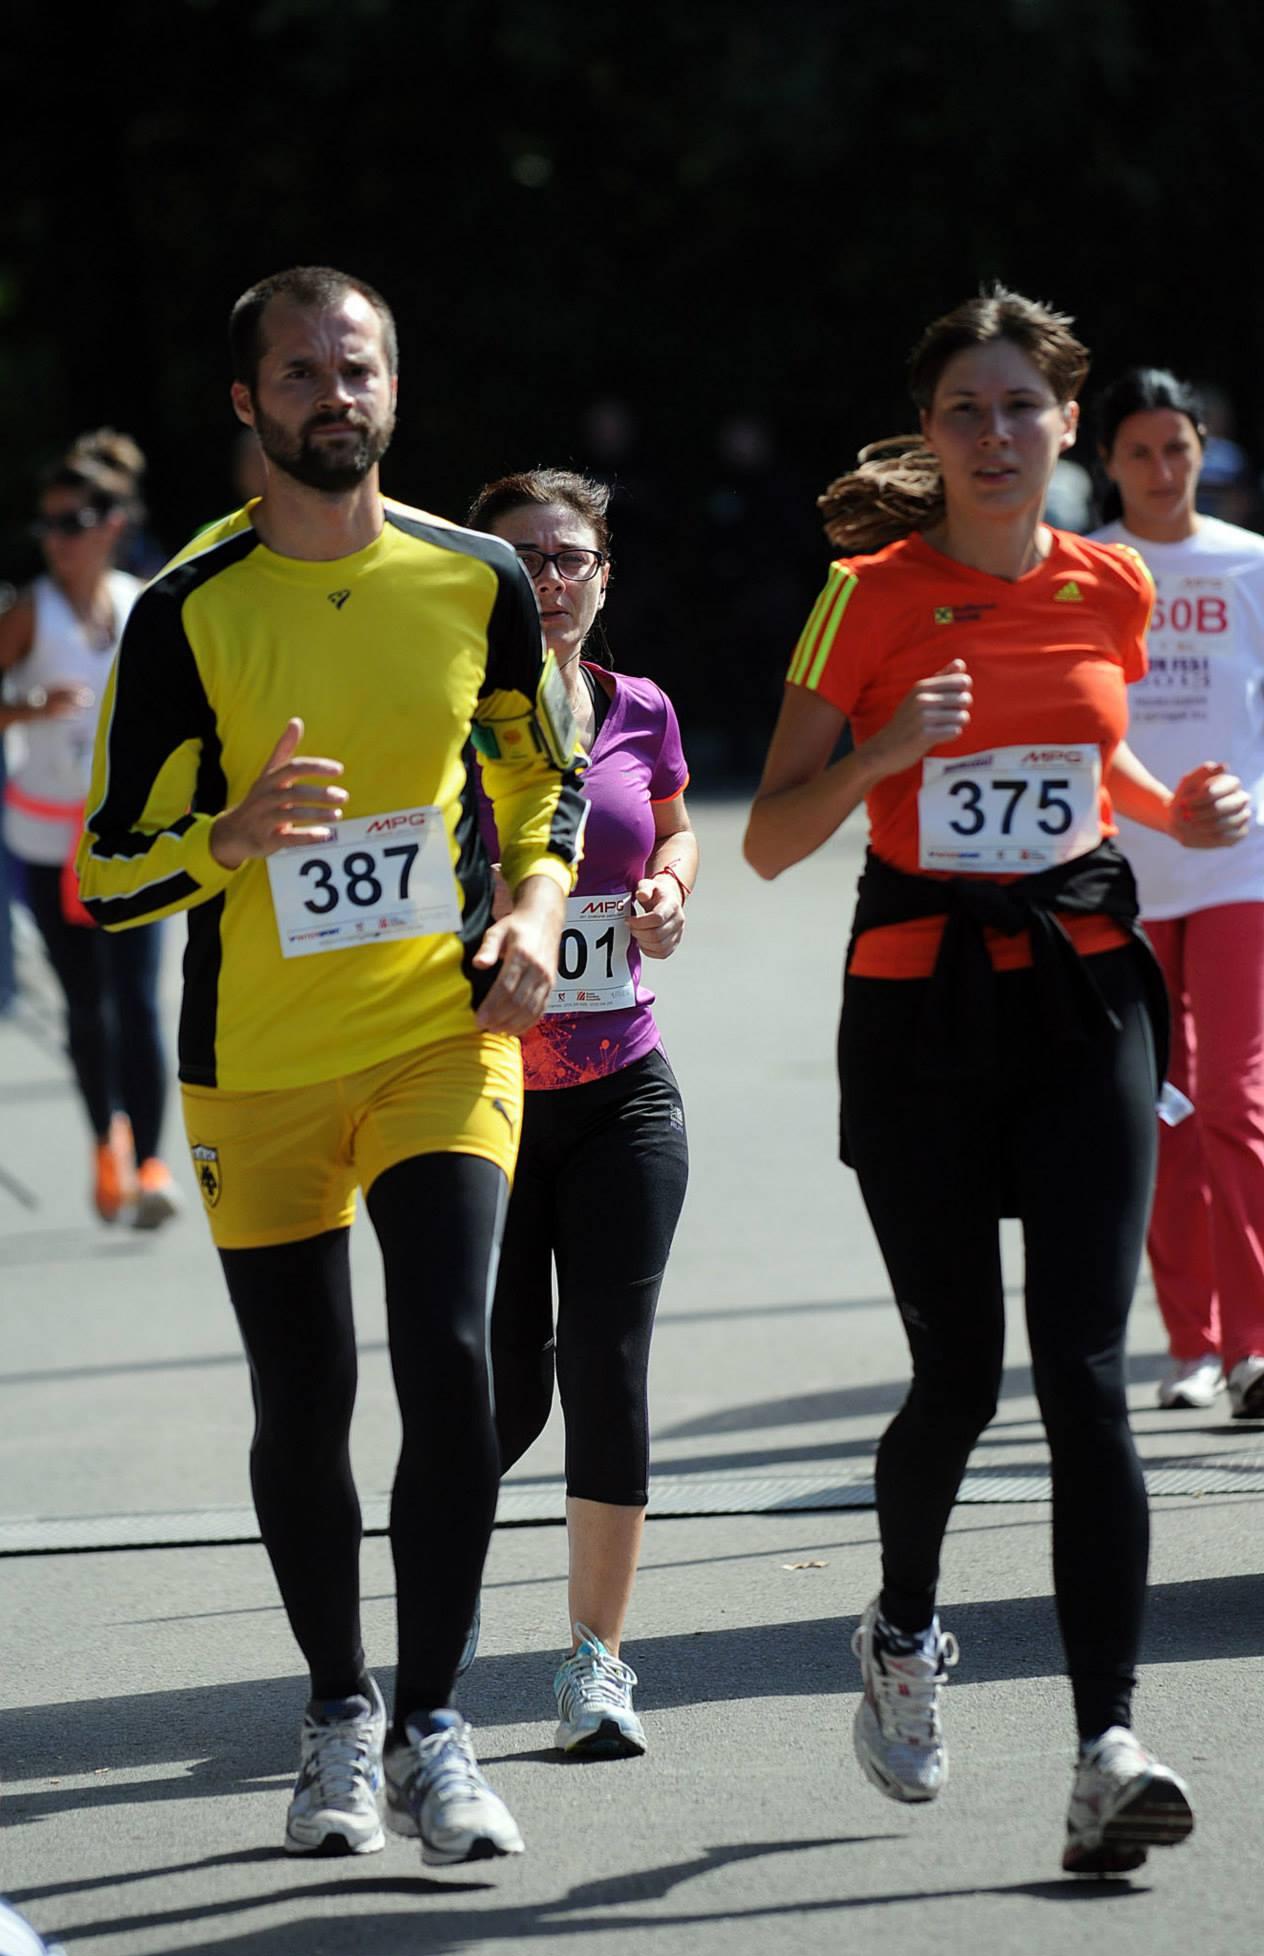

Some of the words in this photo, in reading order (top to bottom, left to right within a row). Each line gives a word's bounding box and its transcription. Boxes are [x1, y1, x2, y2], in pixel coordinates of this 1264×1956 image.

[367, 812, 426, 833] MPG
[949, 780, 1072, 835] 375
[299, 843, 419, 914] 387
[580, 900, 625, 913] MPG
[557, 927, 615, 980] 01
